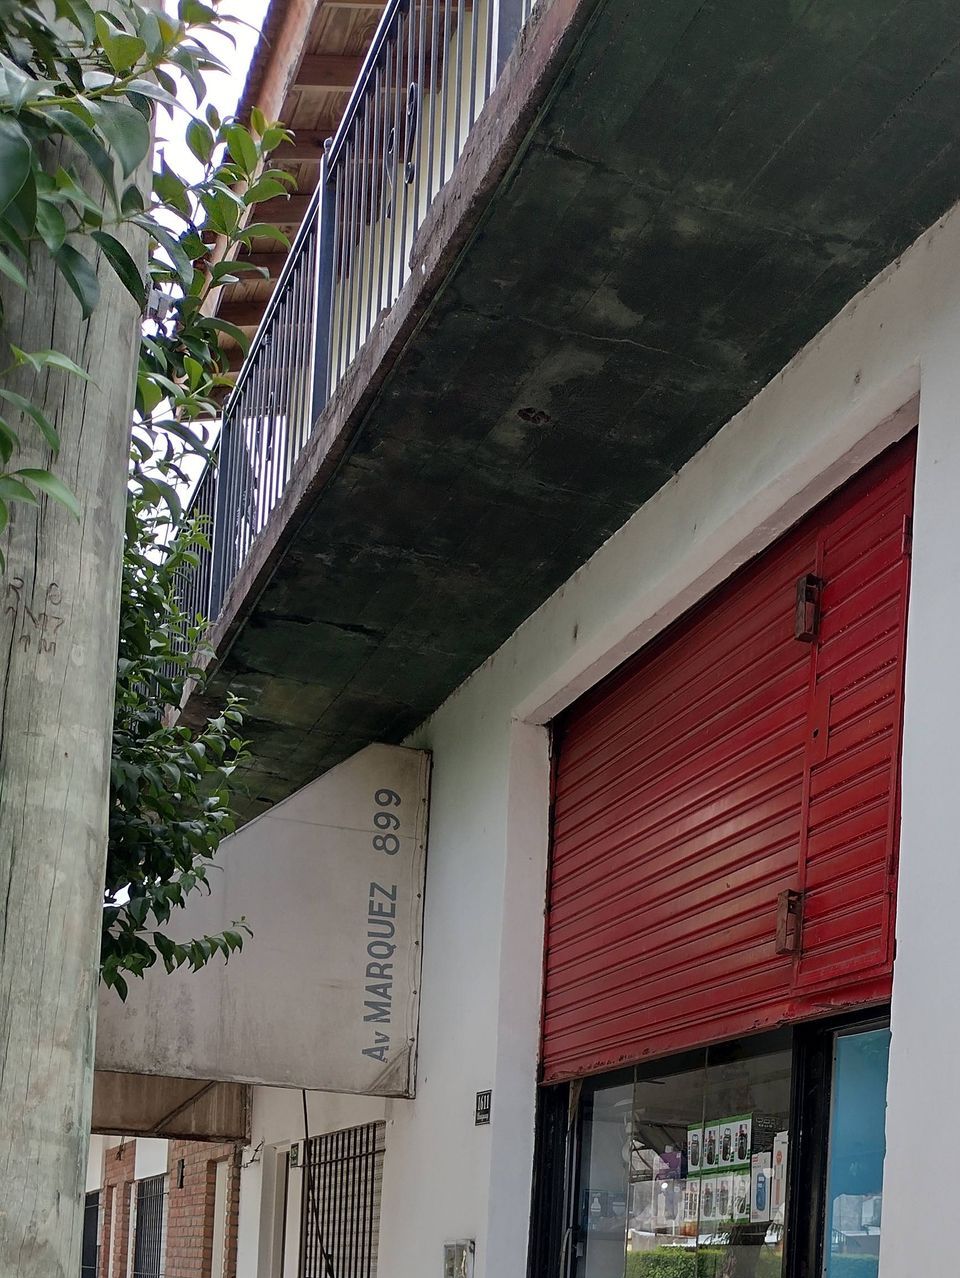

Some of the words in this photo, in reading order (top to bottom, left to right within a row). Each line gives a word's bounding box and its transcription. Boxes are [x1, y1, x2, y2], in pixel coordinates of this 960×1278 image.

[372, 788, 401, 856] 899
[363, 882, 398, 1023] MARQUEZ
[361, 1031, 390, 1064] Av
